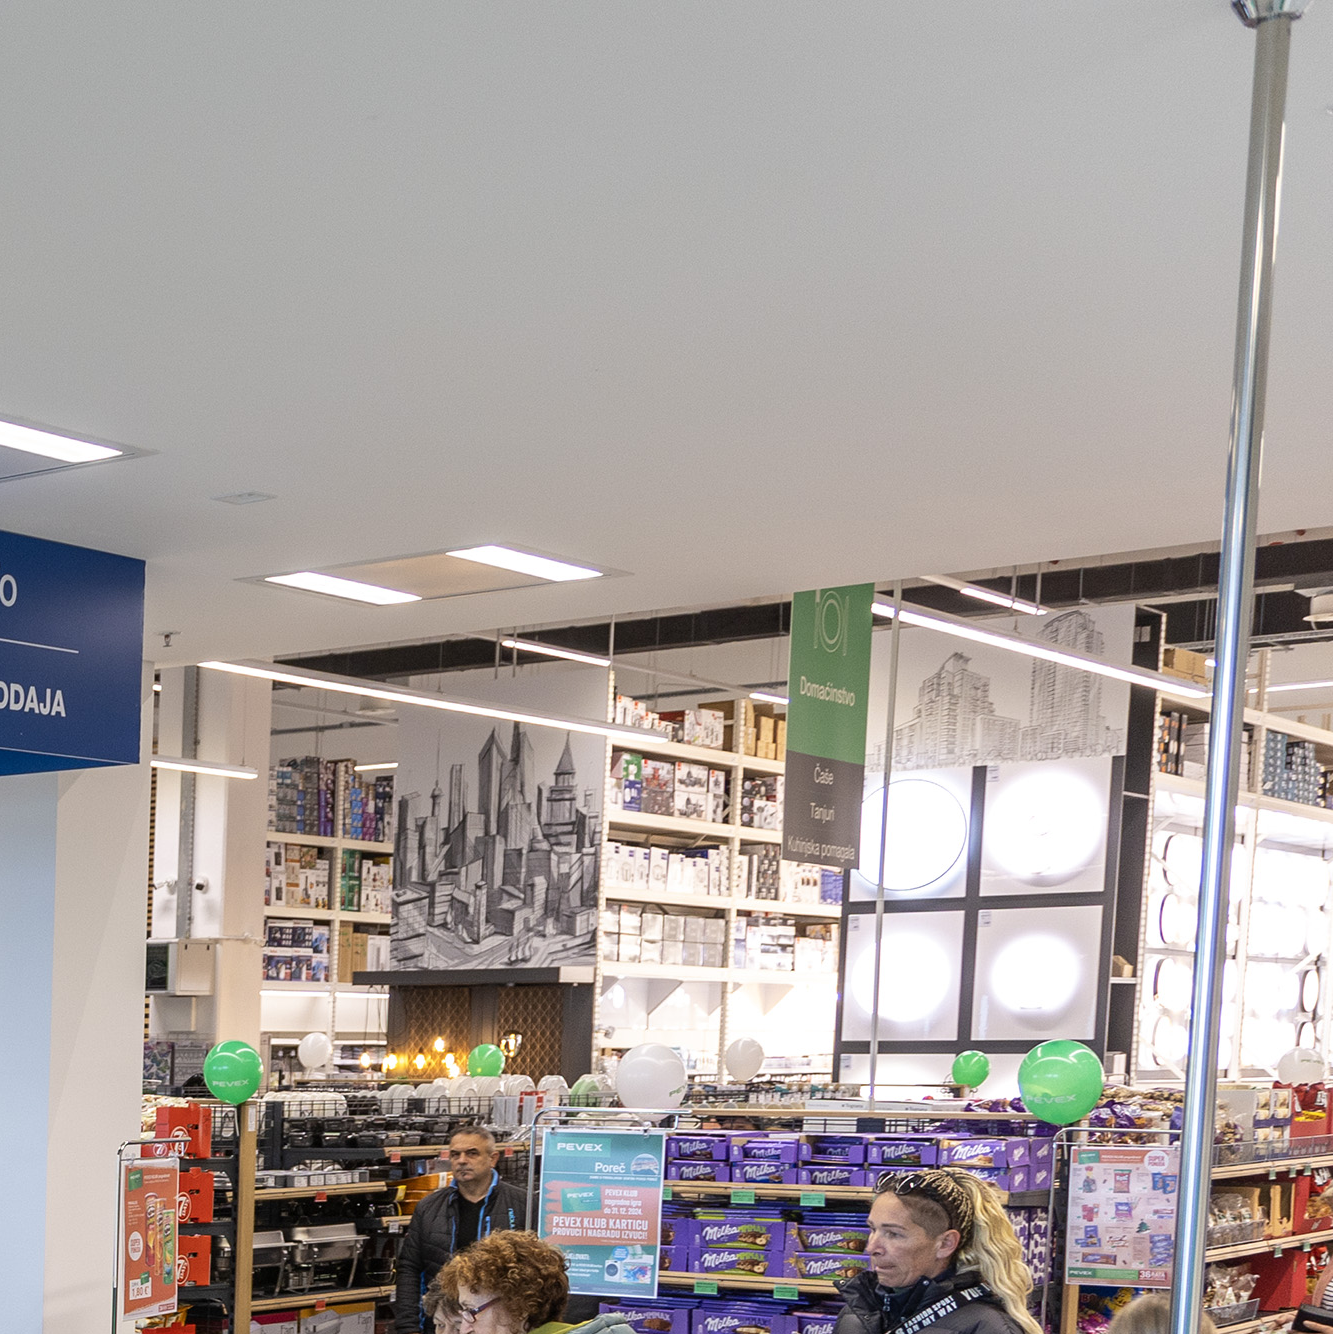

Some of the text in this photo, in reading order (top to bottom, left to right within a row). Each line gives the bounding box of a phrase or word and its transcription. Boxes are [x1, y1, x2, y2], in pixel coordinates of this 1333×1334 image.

[799, 676, 856, 707] Domaćinstvo
[813, 763, 834, 785] Čaše
[809, 802, 835, 824] Tanjuri
[212, 1079, 250, 1087] PEVEX
[1024, 1094, 1077, 1104] PEVEX
[556, 1142, 604, 1152] PEVEX
[679, 1139, 707, 1154] Milka
[882, 1143, 917, 1158] Milka
[951, 1143, 992, 1160] Milka
[594, 1162, 626, 1173] Poreč
[680, 1164, 712, 1177] Milka
[744, 1162, 777, 1178] Milka
[811, 1169, 851, 1184] Milka
[604, 1188, 638, 1197] PEVEX KLUB
[552, 1216, 649, 1231] PEVEX KLUB KARTICU
[552, 1227, 582, 1236] PROVUCI
[587, 1228, 620, 1239] NAGRADU
[621, 1230, 648, 1240] IZVUCI!
[702, 1224, 740, 1241] Milka
[808, 1232, 843, 1246] Milka
[701, 1252, 738, 1268] Milka
[806, 1259, 842, 1274] Milka
[1139, 1270, 1151, 1279] 36
[903, 1295, 955, 1329] FASHION SPORT
[922, 1315, 936, 1327] MY
[937, 1301, 958, 1318] WAY
[705, 1316, 740, 1332] Milka
